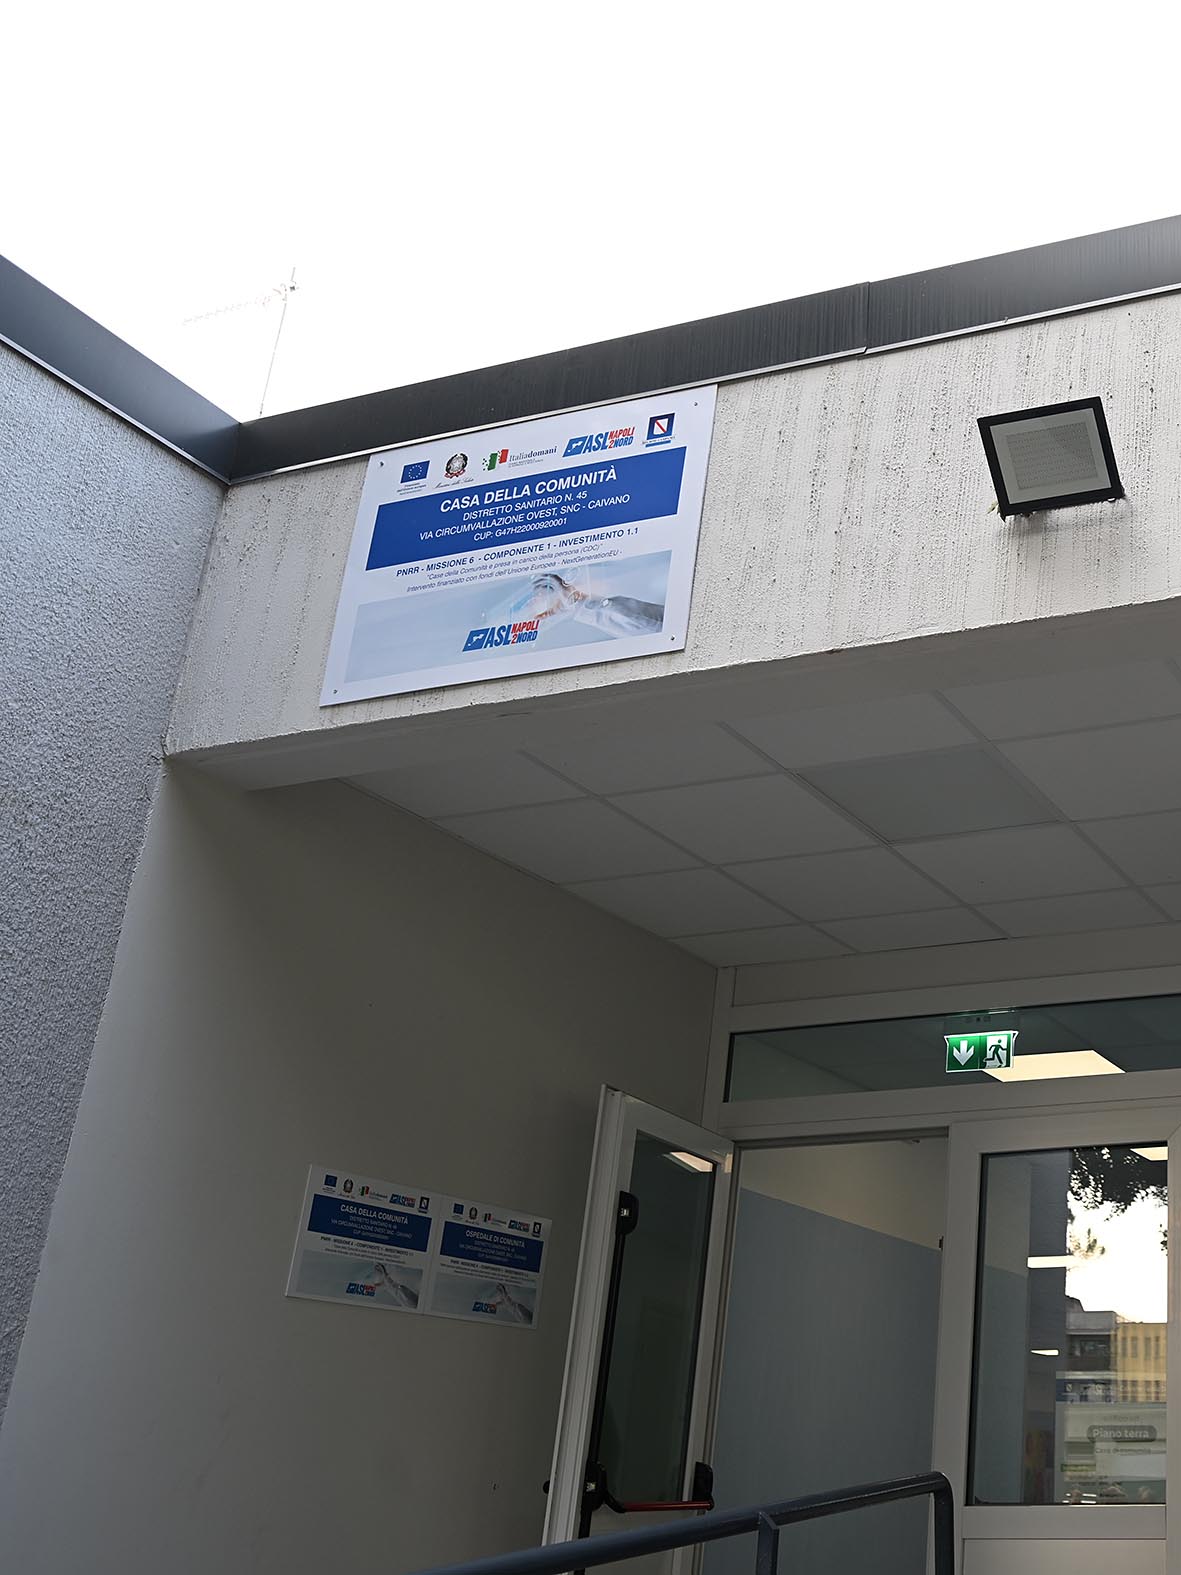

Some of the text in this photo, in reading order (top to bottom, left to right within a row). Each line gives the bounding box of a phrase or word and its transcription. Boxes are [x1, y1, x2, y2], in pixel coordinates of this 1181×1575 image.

[582, 432, 608, 453] ASL
[608, 427, 635, 440] NAPOLI
[440, 465, 617, 513] CASA DELLA COMUNITÀ
[420, 532, 433, 540] VIA
[435, 513, 524, 537] CIRCUMVALLAZIONE
[527, 508, 557, 521] OVEST,
[561, 503, 580, 514] SNC
[588, 494, 630, 509] CAIVANO
[463, 491, 587, 521] DISTRETTO SANITARIO N. 45
[474, 518, 567, 541] CUP: G47H22000920001
[396, 567, 419, 577] PNRR
[426, 558, 467, 572] MISSIONE
[483, 544, 544, 561] COMPONENTE
[558, 529, 624, 547] INVESTIMENTO
[627, 527, 638, 535] 1.1
[460, 564, 487, 575] Comunità
[407, 582, 436, 593] Intervento
[484, 624, 511, 649] ASL
[511, 620, 539, 634] NAPOLI
[1092, 1428, 1149, 1438] Piano terra
